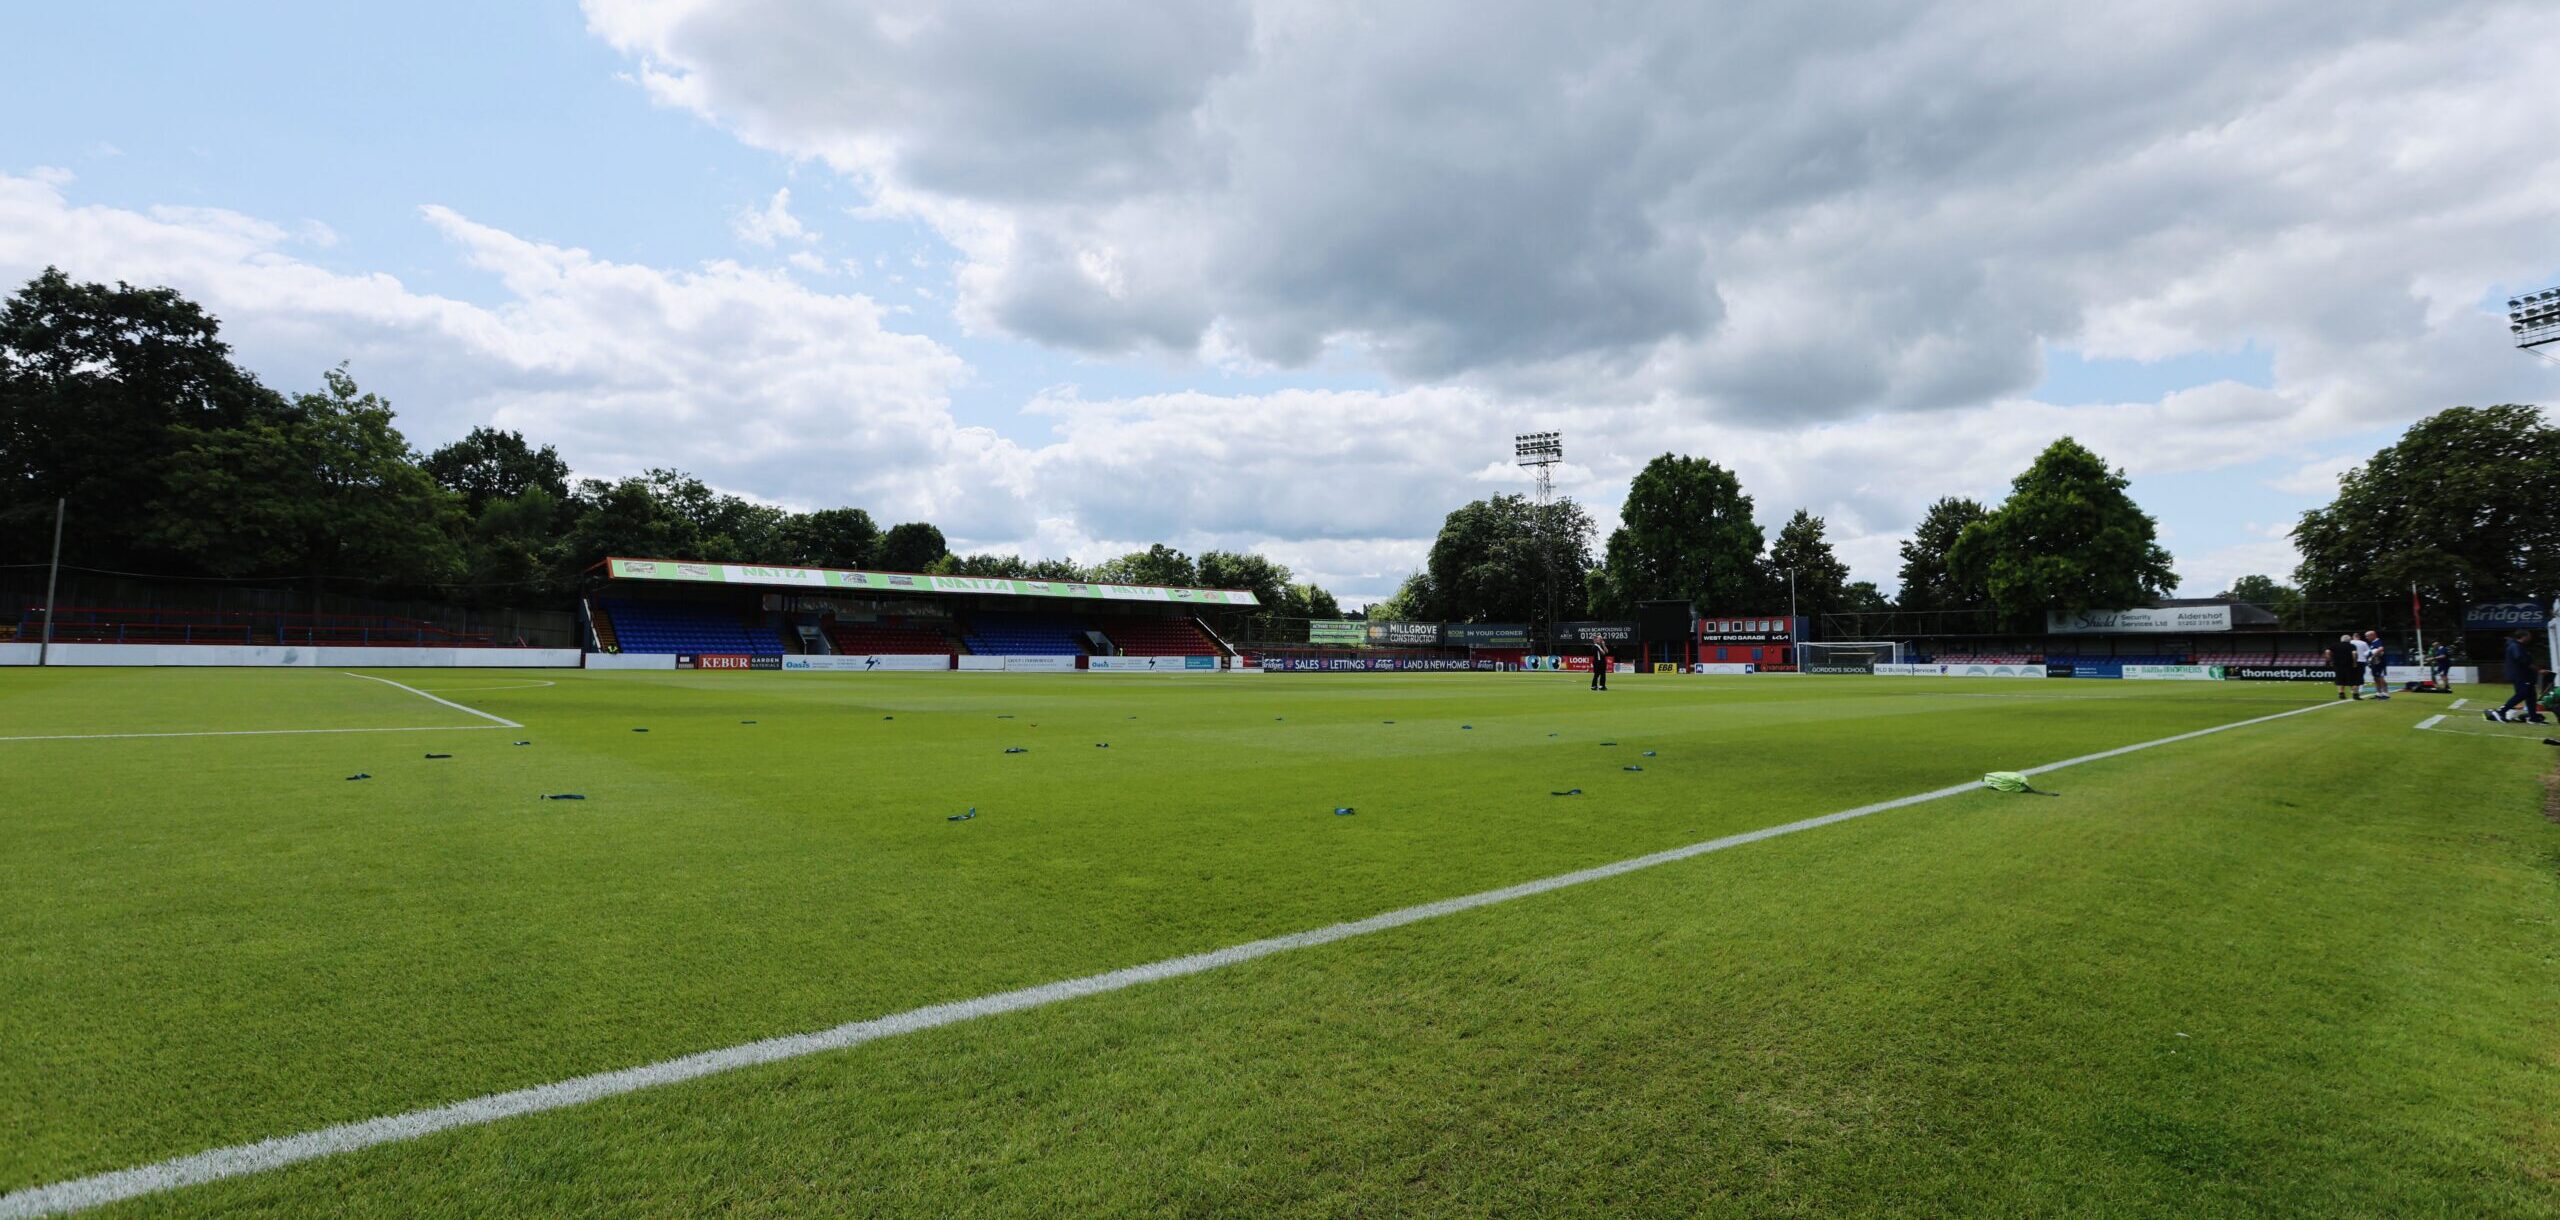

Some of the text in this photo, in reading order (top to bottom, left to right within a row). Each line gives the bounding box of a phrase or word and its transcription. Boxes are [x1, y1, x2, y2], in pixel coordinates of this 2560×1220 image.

[2466, 608, 2544, 623] Bridges
[1390, 624, 1437, 634] MILLGROVE
[1390, 634, 1437, 643] CONSTRUCTION
[1602, 632, 1629, 640] 219283
[702, 657, 748, 668] KEBUR
[785, 659, 810, 668] Oasis
[1295, 660, 1319, 669] SALES
[1330, 660, 1365, 669] LETTINGS
[1403, 660, 1423, 669] LAND
[1424, 660, 1429, 669] &
[1430, 660, 1446, 669] NEW
[1446, 660, 1470, 669] HOMES
[1657, 663, 1673, 671] EBB
[2241, 668, 2336, 679] thornettpsl.com
